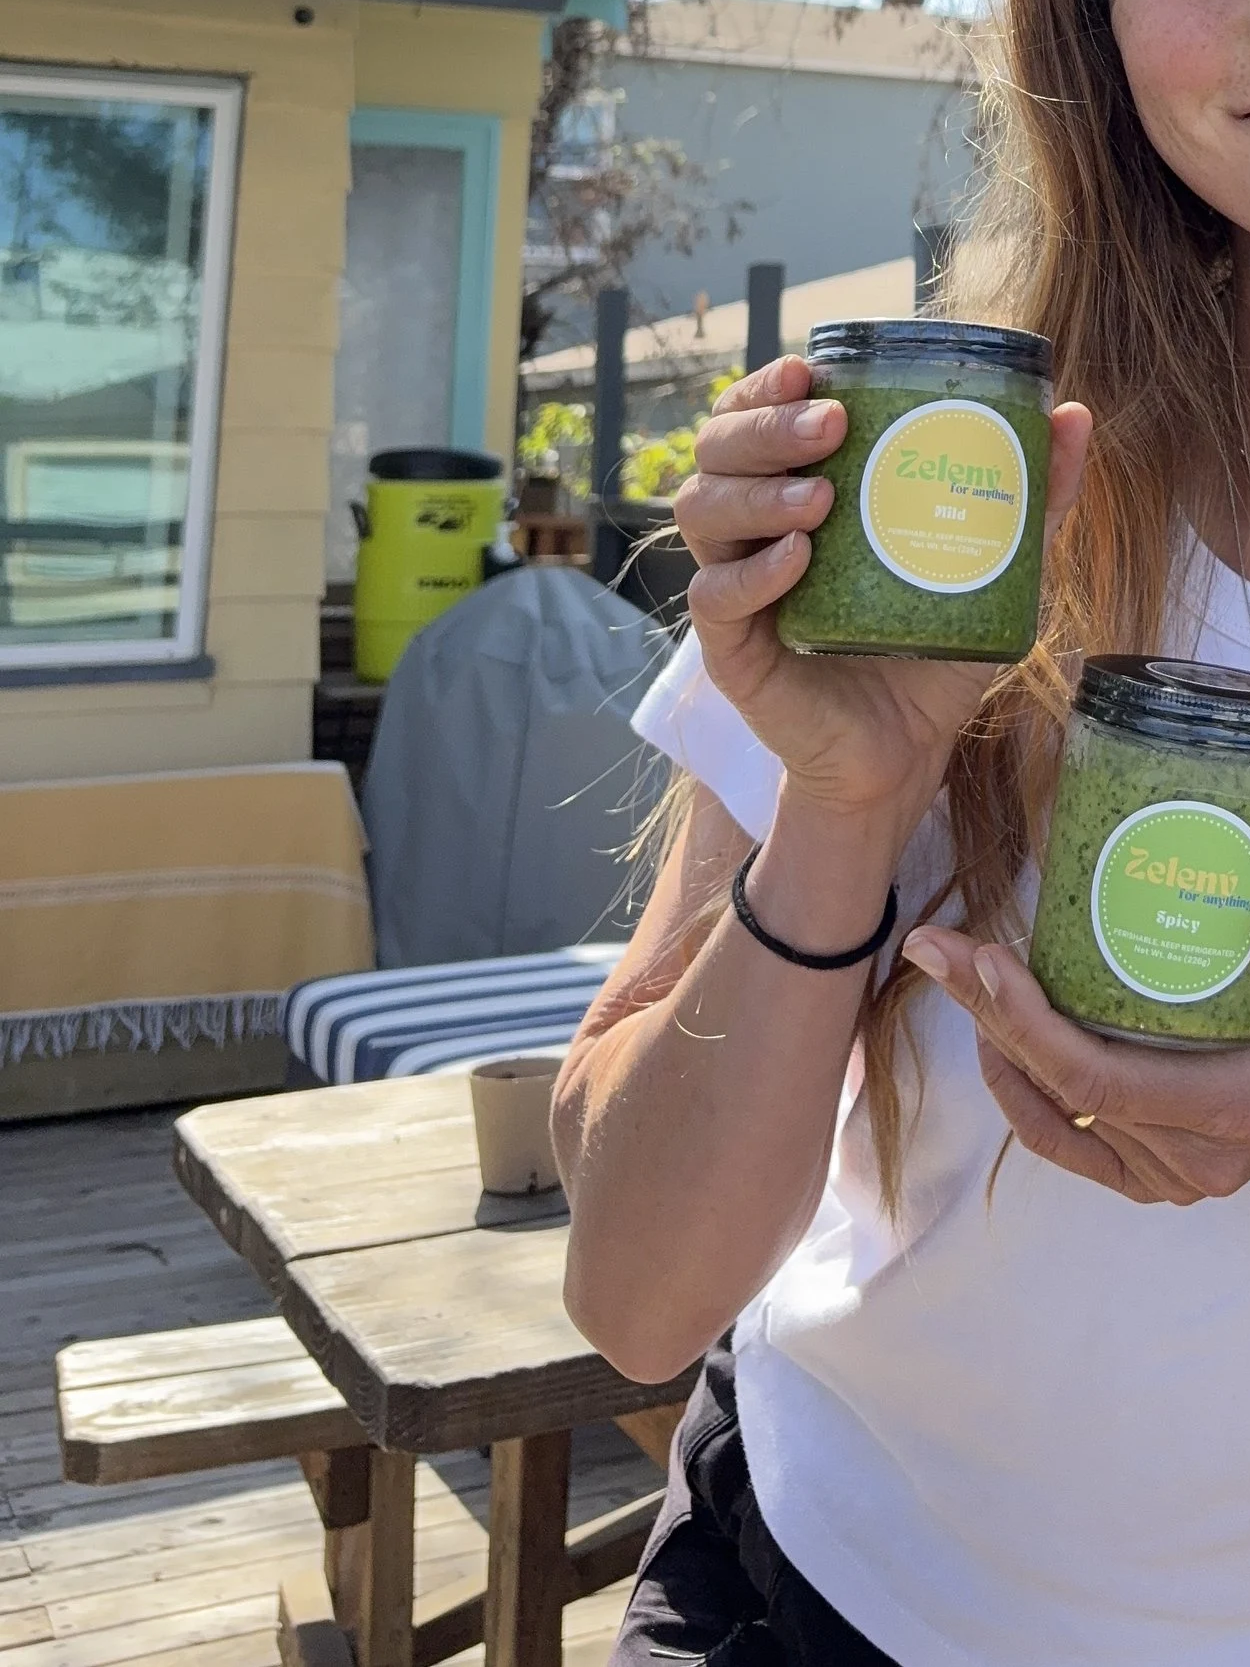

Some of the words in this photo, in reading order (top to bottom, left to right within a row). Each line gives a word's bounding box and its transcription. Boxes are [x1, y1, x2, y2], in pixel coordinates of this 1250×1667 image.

[950, 482, 969, 495] for
[971, 488, 1015, 505] anything
[934, 505, 967, 521] Mild
[910, 540, 925, 549] Net
[1179, 888, 1200, 902] for
[1156, 910, 1200, 934] Spicy
[1134, 945, 1150, 955] Net
[1160, 940, 1181, 950] KEEP
[1181, 944, 1236, 958] REFRIGERATED
